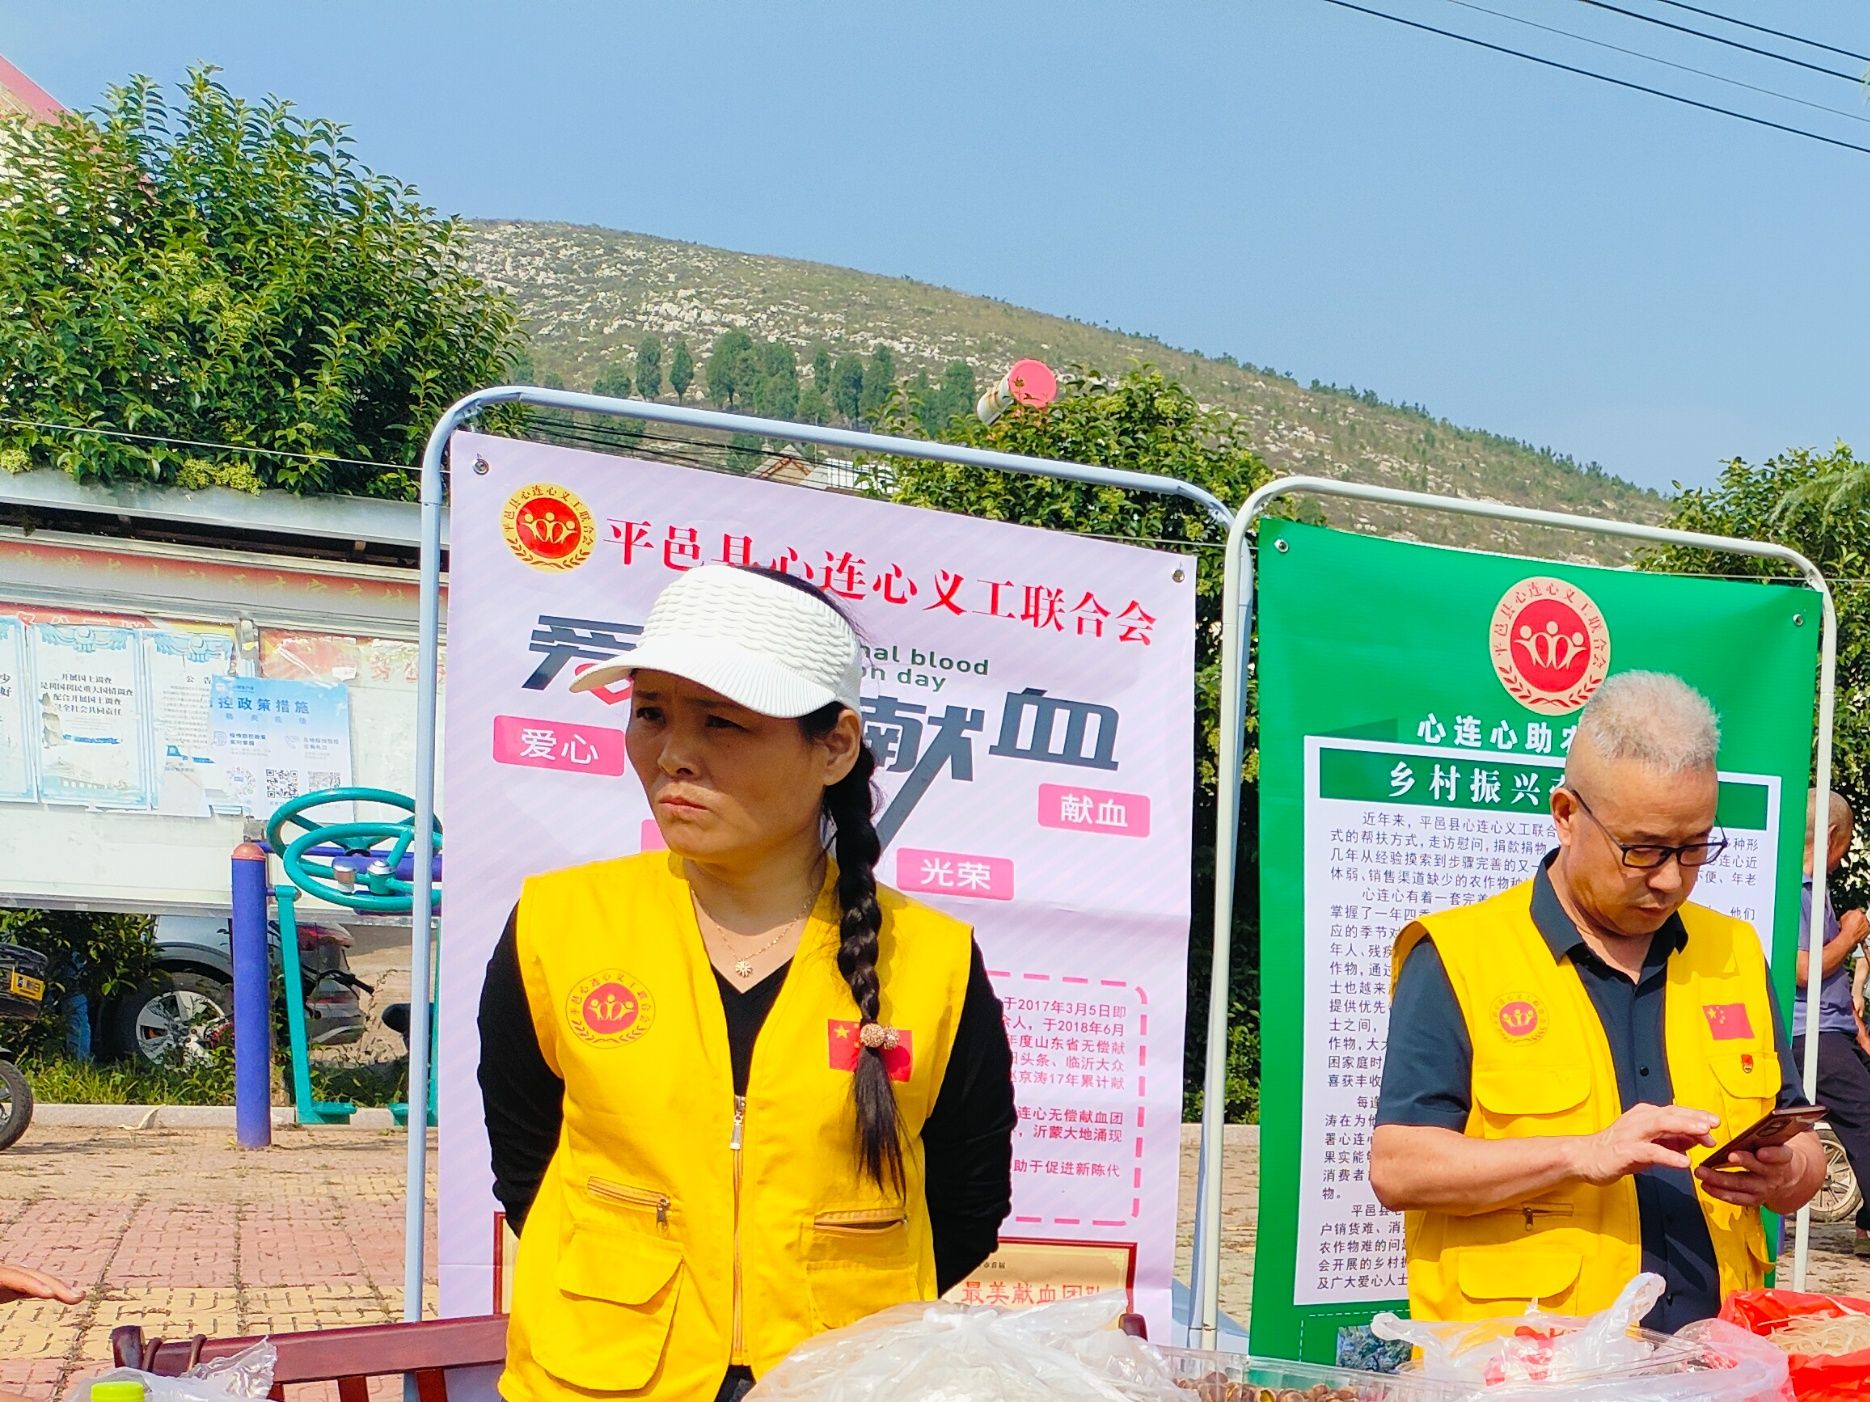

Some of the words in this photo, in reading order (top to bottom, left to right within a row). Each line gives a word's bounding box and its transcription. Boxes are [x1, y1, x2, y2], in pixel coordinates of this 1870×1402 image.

[910, 649, 989, 676] blood
[896, 668, 947, 692] day
[519, 727, 599, 765] 爱心
[1060, 794, 1128, 828] 献血
[920, 858, 992, 890] 光荣
[1328, 1055, 1382, 1069] 困家庭时
[1328, 1074, 1381, 1088] 喜获丰收
